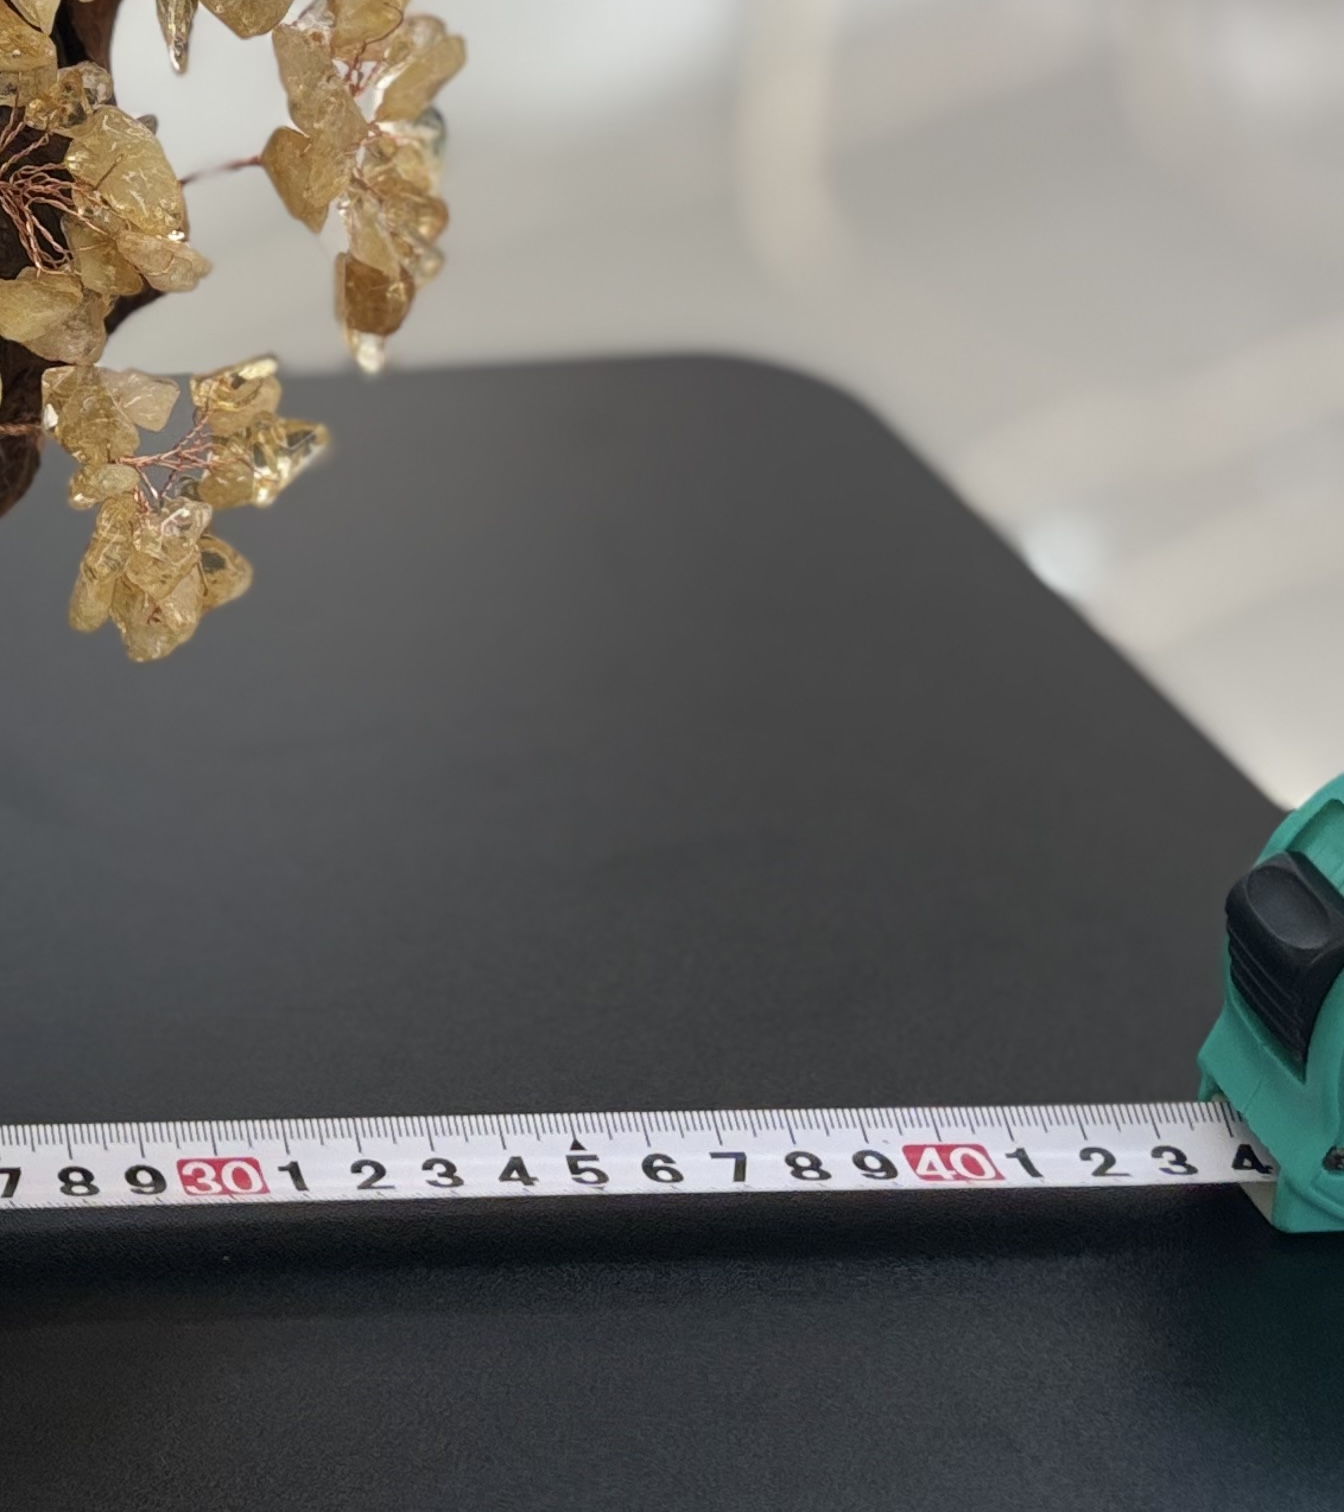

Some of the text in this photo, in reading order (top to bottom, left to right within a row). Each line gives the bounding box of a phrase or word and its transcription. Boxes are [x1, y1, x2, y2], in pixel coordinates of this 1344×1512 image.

[57, 1166, 100, 1197] 8
[124, 1164, 167, 1195] 9
[182, 1160, 263, 1194] 30
[278, 1161, 310, 1191] 1
[350, 1158, 395, 1190] 2
[421, 1157, 465, 1188] 3
[498, 1156, 539, 1186] 4
[565, 1155, 609, 1185] 5
[641, 1153, 684, 1183] 6
[709, 1152, 747, 1182] 7
[784, 1151, 832, 1181] 8
[852, 1149, 899, 1180] 9
[915, 1147, 996, 1180] 40
[1006, 1147, 1043, 1178] 1
[1080, 1147, 1130, 1177] 2
[1151, 1145, 1199, 1176] 3
[1231, 1143, 1274, 1175] 4
